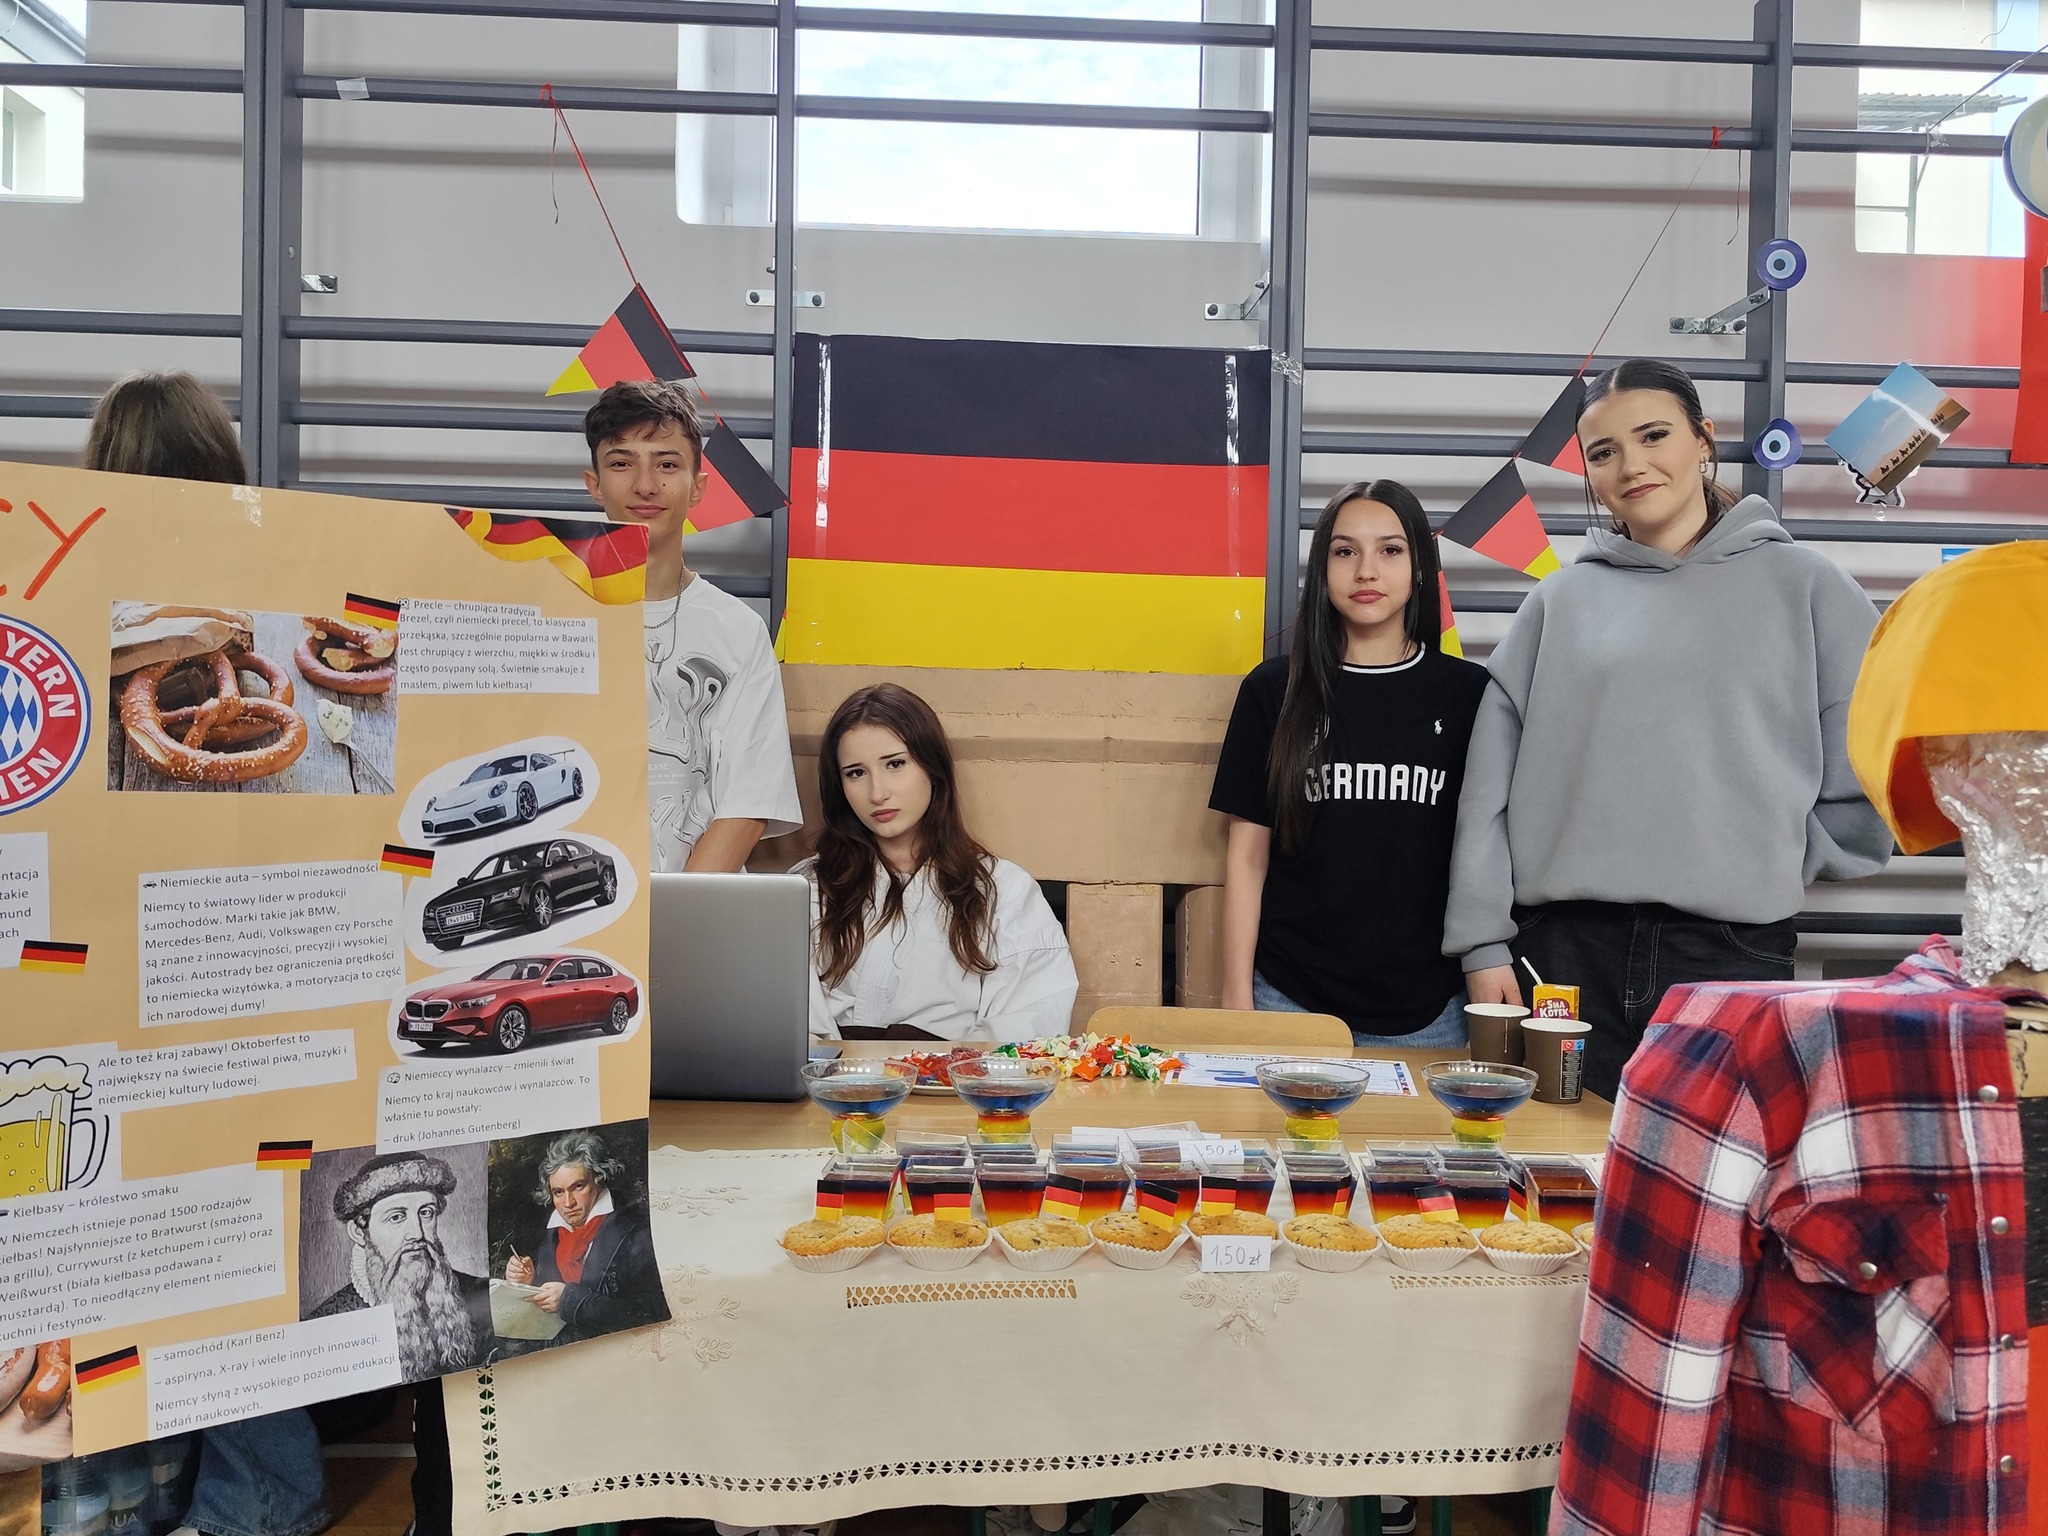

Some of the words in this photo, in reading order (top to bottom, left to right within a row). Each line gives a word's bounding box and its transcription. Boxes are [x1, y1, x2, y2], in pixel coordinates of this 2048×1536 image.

[0, 498, 106, 601] Y
[399, 613, 432, 624] Brezel,
[434, 614, 454, 625] czyli
[456, 615, 499, 624] niemiecki
[501, 617, 531, 627] precel,
[545, 615, 586, 628] klasyczna
[414, 600, 443, 609] Precle
[453, 602, 498, 614] chrupiąca
[399, 630, 448, 641] przekąska,
[451, 631, 502, 642] szczególnie
[504, 633, 549, 643] popularna
[561, 633, 596, 642] Bawarii.
[399, 647, 418, 656] Jest
[420, 647, 465, 658] chrupiący
[474, 648, 516, 658] wierzchu,
[519, 648, 548, 659] miękki
[560, 649, 590, 658] środku
[399, 664, 429, 674] często
[432, 665, 476, 674] posypany
[478, 664, 498, 675] solą.
[500, 662, 539, 673] Świetnie
[541, 664, 578, 675] smakuje
[400, 680, 440, 690] masłem,
[442, 680, 473, 690] piwem
[475, 680, 490, 689] lub
[492, 680, 532, 691] kiełbasą!
[1305, 763, 1446, 806] GERMANY
[0, 868, 39, 881] ntacja
[160, 874, 221, 887] Niemieckie
[224, 873, 249, 883] auta
[261, 868, 300, 882] symbol
[302, 862, 380, 877] niezawodności
[143, 902, 186, 912] Niemcy
[203, 897, 256, 908] światowy
[258, 893, 283, 903] lider
[298, 887, 346, 902] produkcji
[225, 912, 257, 923] Marki
[260, 910, 286, 920] takie
[289, 908, 304, 920] jak
[307, 905, 339, 916] BMW,
[145, 934, 234, 949] Mercedes-Benz,
[237, 929, 265, 940] Audi,
[268, 925, 331, 937] Volkswagen
[334, 923, 350, 932] czy
[353, 918, 393, 929] Porsche
[160, 955, 194, 966] znane
[205, 944, 292, 961] innowacyjności,
[295, 939, 335, 954] precyzji
[342, 934, 387, 948] wysokiej
[146, 972, 187, 988] jakości.
[190, 965, 252, 980] Autostrady
[255, 964, 273, 974] bez
[276, 956, 342, 973] ograniczenia
[345, 950, 394, 966] prędkości
[161, 987, 218, 1001] niemiecka
[221, 980, 282, 995] wizytówka,
[295, 971, 358, 986] motoryzacja
[375, 966, 401, 978] część
[147, 1011, 163, 1022] ich
[166, 1003, 227, 1019] narodowej
[230, 999, 265, 1011] dumy!
[1539, 1007, 1570, 1018] KOTEK
[97, 1057, 117, 1068] Ale
[135, 1052, 153, 1063] też
[156, 1049, 177, 1061] kraj
[181, 1043, 227, 1057] zabawy!
[231, 1035, 296, 1051] Oktoberfest
[98, 1071, 161, 1087] największy
[164, 1069, 178, 1078] na
[182, 1062, 223, 1075] świecie
[226, 1055, 269, 1069] festiwal
[272, 1053, 301, 1066] piwa,
[304, 1046, 341, 1059] muzyki
[404, 1070, 453, 1081] Niemieccy
[455, 1065, 503, 1077] wynalazcy
[513, 1058, 548, 1070] zmienili
[550, 1056, 574, 1066] świat
[98, 1087, 165, 1105] niemieckiej
[168, 1083, 209, 1095] kultury
[212, 1074, 260, 1089] ludowej.
[385, 1095, 421, 1106] Niemcy
[423, 1093, 433, 1101] to
[436, 1089, 453, 1100] kraj
[456, 1083, 512, 1097] naukowców
[519, 1077, 576, 1090] wynalazców.
[578, 1075, 590, 1083] To
[384, 1110, 421, 1122] właśnie
[436, 1103, 481, 1117] powstały:
[392, 1132, 415, 1143] druk
[417, 1127, 465, 1142] (Johannes
[467, 1118, 520, 1133] Gutenberg)
[13, 1203, 64, 1218] Kiełbasy
[79, 1192, 138, 1208] królestwo
[141, 1185, 178, 1198] smaku
[12, 1223, 79, 1243] Niemczech
[82, 1216, 126, 1231] istnieje
[129, 1208, 166, 1226] ponad
[170, 1204, 198, 1217] 1500
[201, 1196, 251, 1212] rodzajów
[0, 1247, 42, 1265] iełbas!
[46, 1235, 132, 1256] Najsłynniejsze
[135, 1232, 148, 1241] to
[151, 1221, 206, 1238] Bratwurst
[210, 1212, 262, 1229] (smażona
[13, 1265, 53, 1283] grillu),
[56, 1254, 123, 1273] Currywurst
[127, 1251, 137, 1262] (z
[140, 1240, 204, 1258] ketchupem
[213, 1230, 246, 1245] curry)
[249, 1228, 272, 1239] oraz
[1248, 1247, 1263, 1266] zł
[66, 1276, 100, 1292] (biała
[104, 1268, 151, 1283] kiełbasa
[154, 1256, 213, 1276] podawana
[74, 1297, 87, 1307] To
[91, 1284, 160, 1304] nieodłączny
[163, 1274, 210, 1290] element
[214, 1260, 276, 1281] niemieckiej
[0, 1324, 36, 1341] uchni
[46, 1313, 106, 1331] festynów.
[164, 1340, 223, 1361] samochód
[226, 1334, 252, 1350] (Karl
[255, 1328, 285, 1343] Benz)
[164, 1368, 216, 1385] aspiryna,
[219, 1361, 248, 1374] X-ray
[257, 1352, 286, 1366] wiele
[289, 1344, 324, 1359] innych
[327, 1333, 380, 1352] innowacji.
[155, 1396, 198, 1412] Niemcy
[201, 1389, 230, 1402] słyną
[242, 1375, 300, 1393] wysokiego
[303, 1365, 349, 1383] poziomu
[352, 1353, 395, 1370] edukacji
[155, 1414, 191, 1431] badań
[195, 1400, 263, 1422] naukowych.
